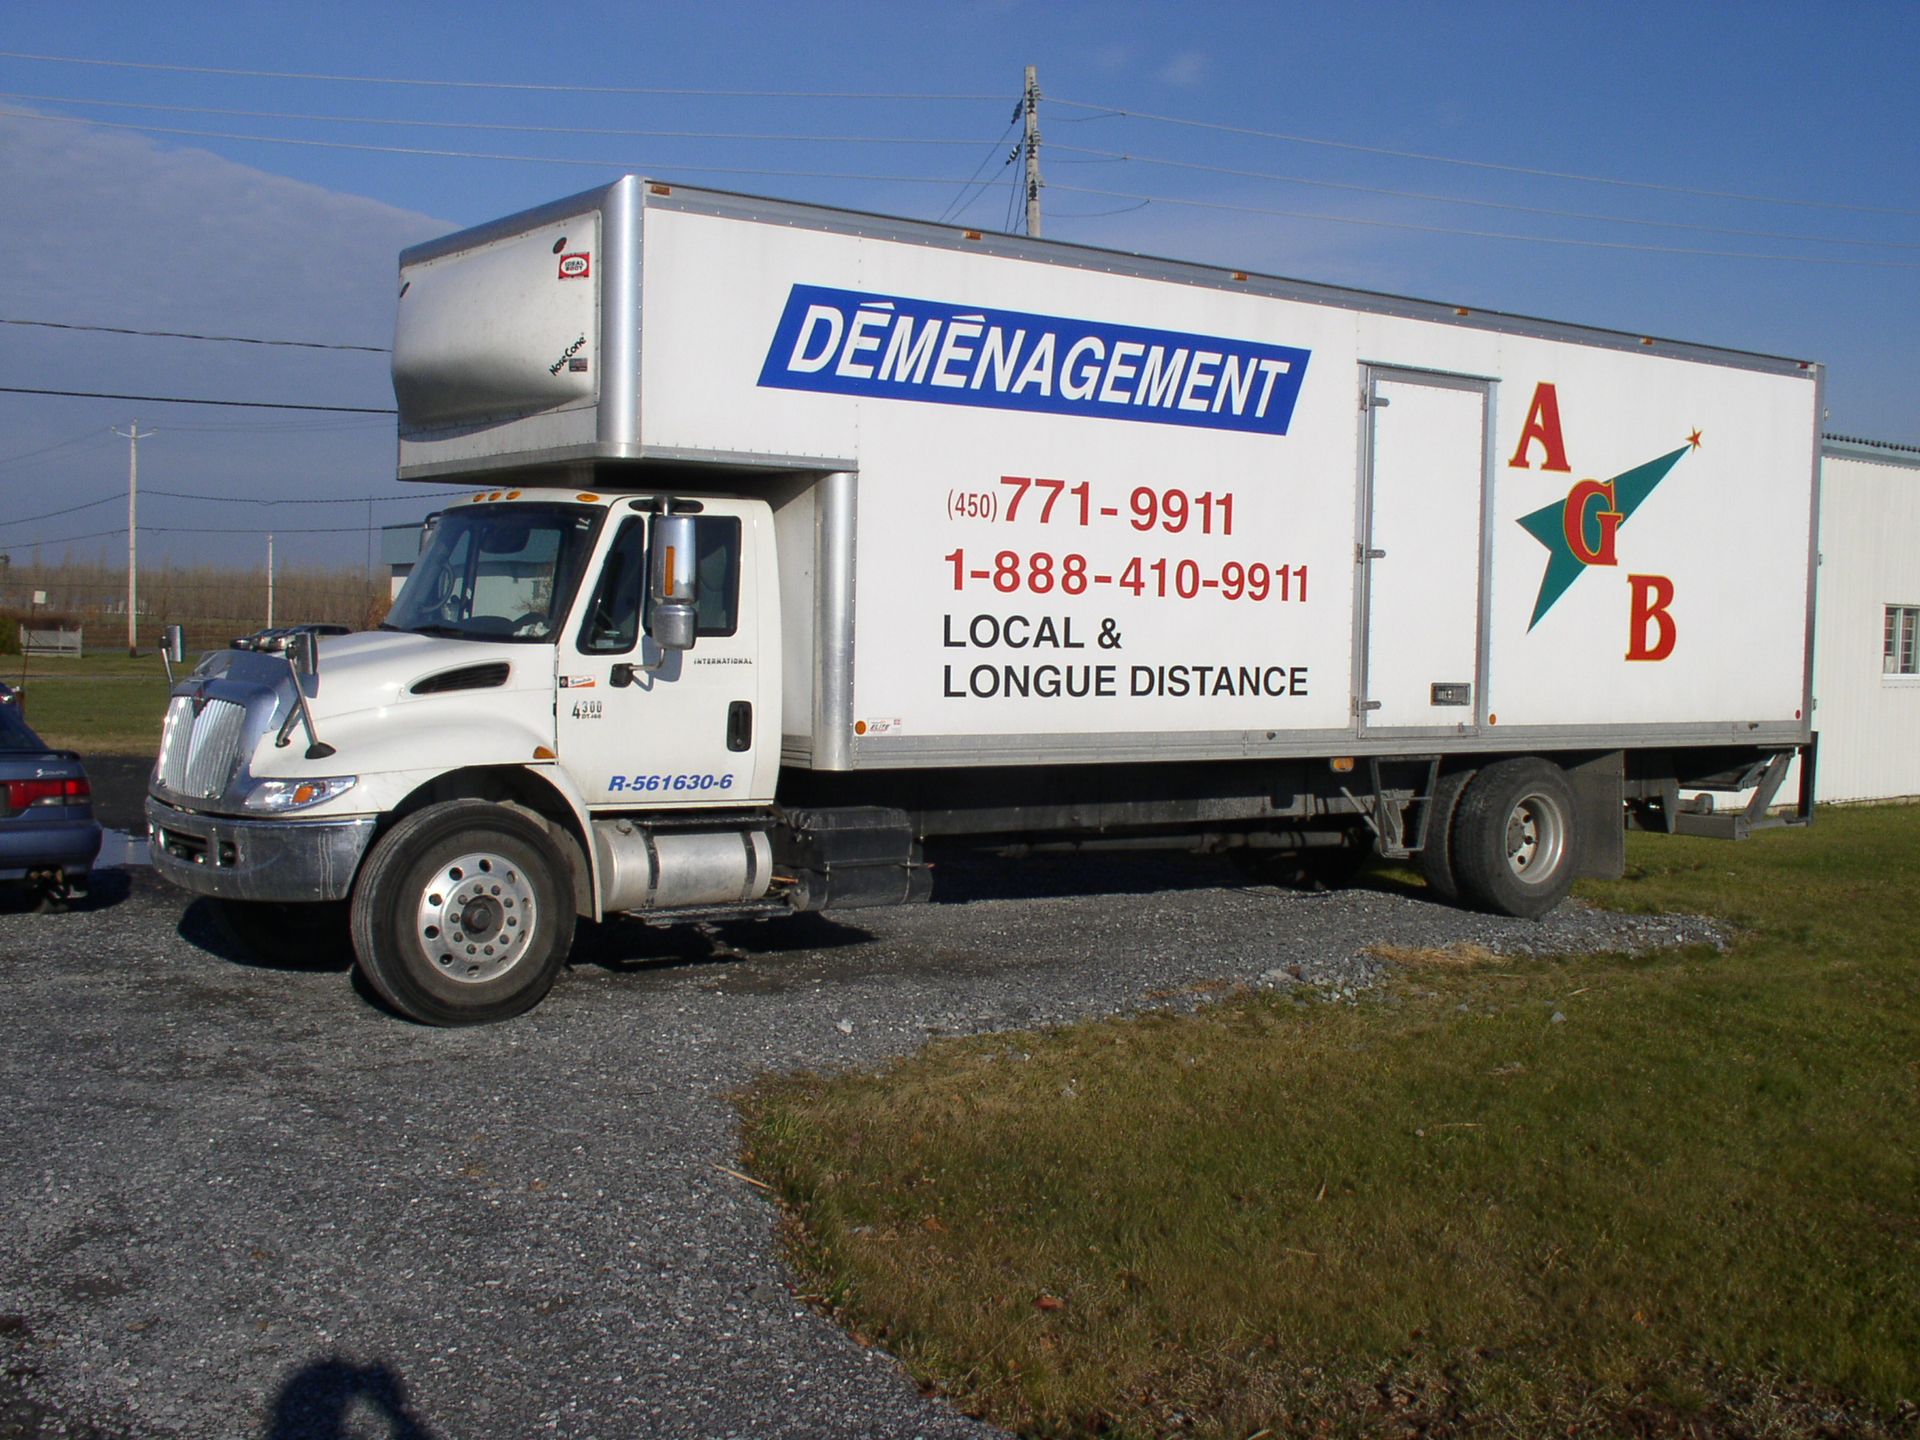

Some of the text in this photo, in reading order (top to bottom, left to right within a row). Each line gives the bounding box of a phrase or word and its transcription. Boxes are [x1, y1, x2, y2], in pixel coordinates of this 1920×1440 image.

[787, 302, 1290, 418] DÉMÉNAGEMENT
[1508, 382, 1677, 661] A G B
[945, 548, 1308, 602] 1-888-410-9911
[944, 614, 1122, 649] LOCAL &
[944, 665, 1308, 697] LONGUE DISTANCE
[572, 700, 603, 719] 4300
[608, 774, 734, 791] R-561630-6
